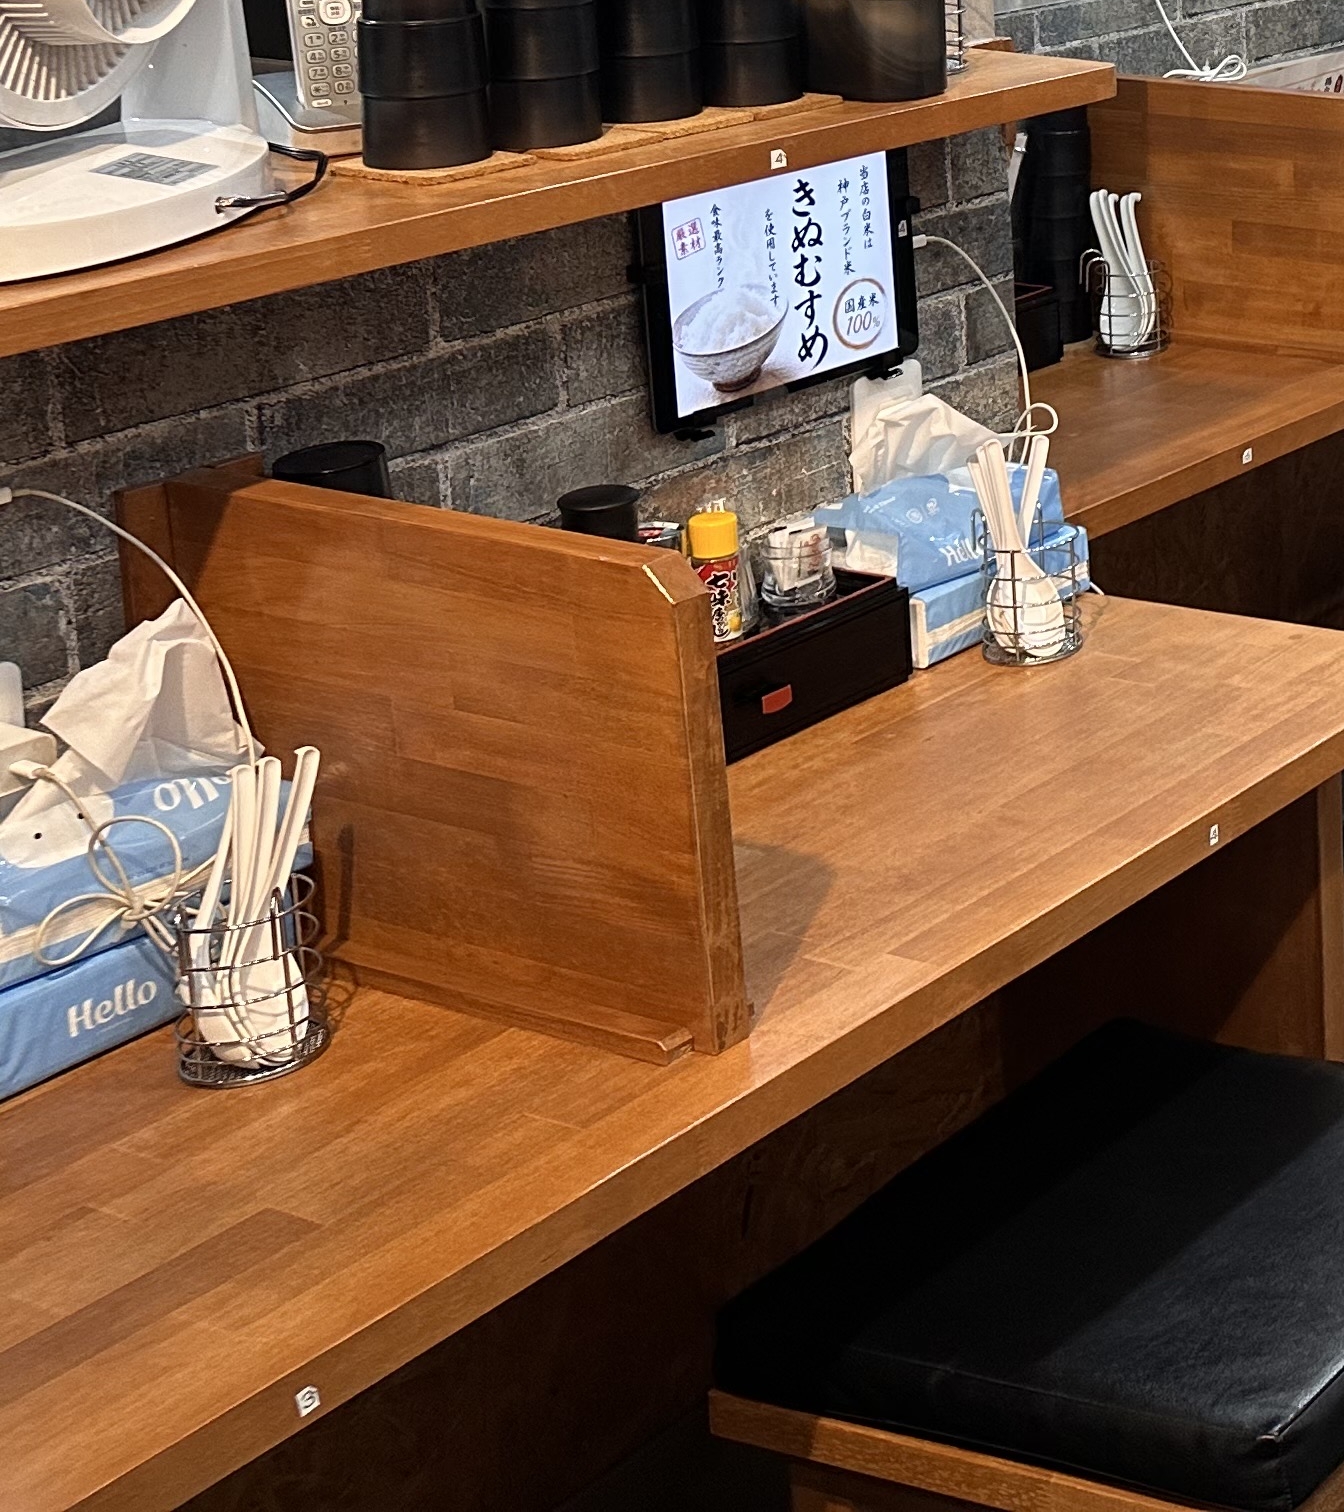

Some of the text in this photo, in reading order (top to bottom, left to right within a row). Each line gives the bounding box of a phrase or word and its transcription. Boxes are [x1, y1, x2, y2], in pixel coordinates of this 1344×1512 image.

[710, 203, 724, 289] 食味最高ランク
[837, 178, 856, 276] 神戸ブランド米
[859, 164, 875, 250] 当店の白米は
[763, 208, 780, 308] を使用しています
[791, 178, 829, 371] きぬむすめ
[844, 291, 880, 315] 国産米
[846, 309, 882, 337] 100%
[66, 979, 159, 1039] Hello
